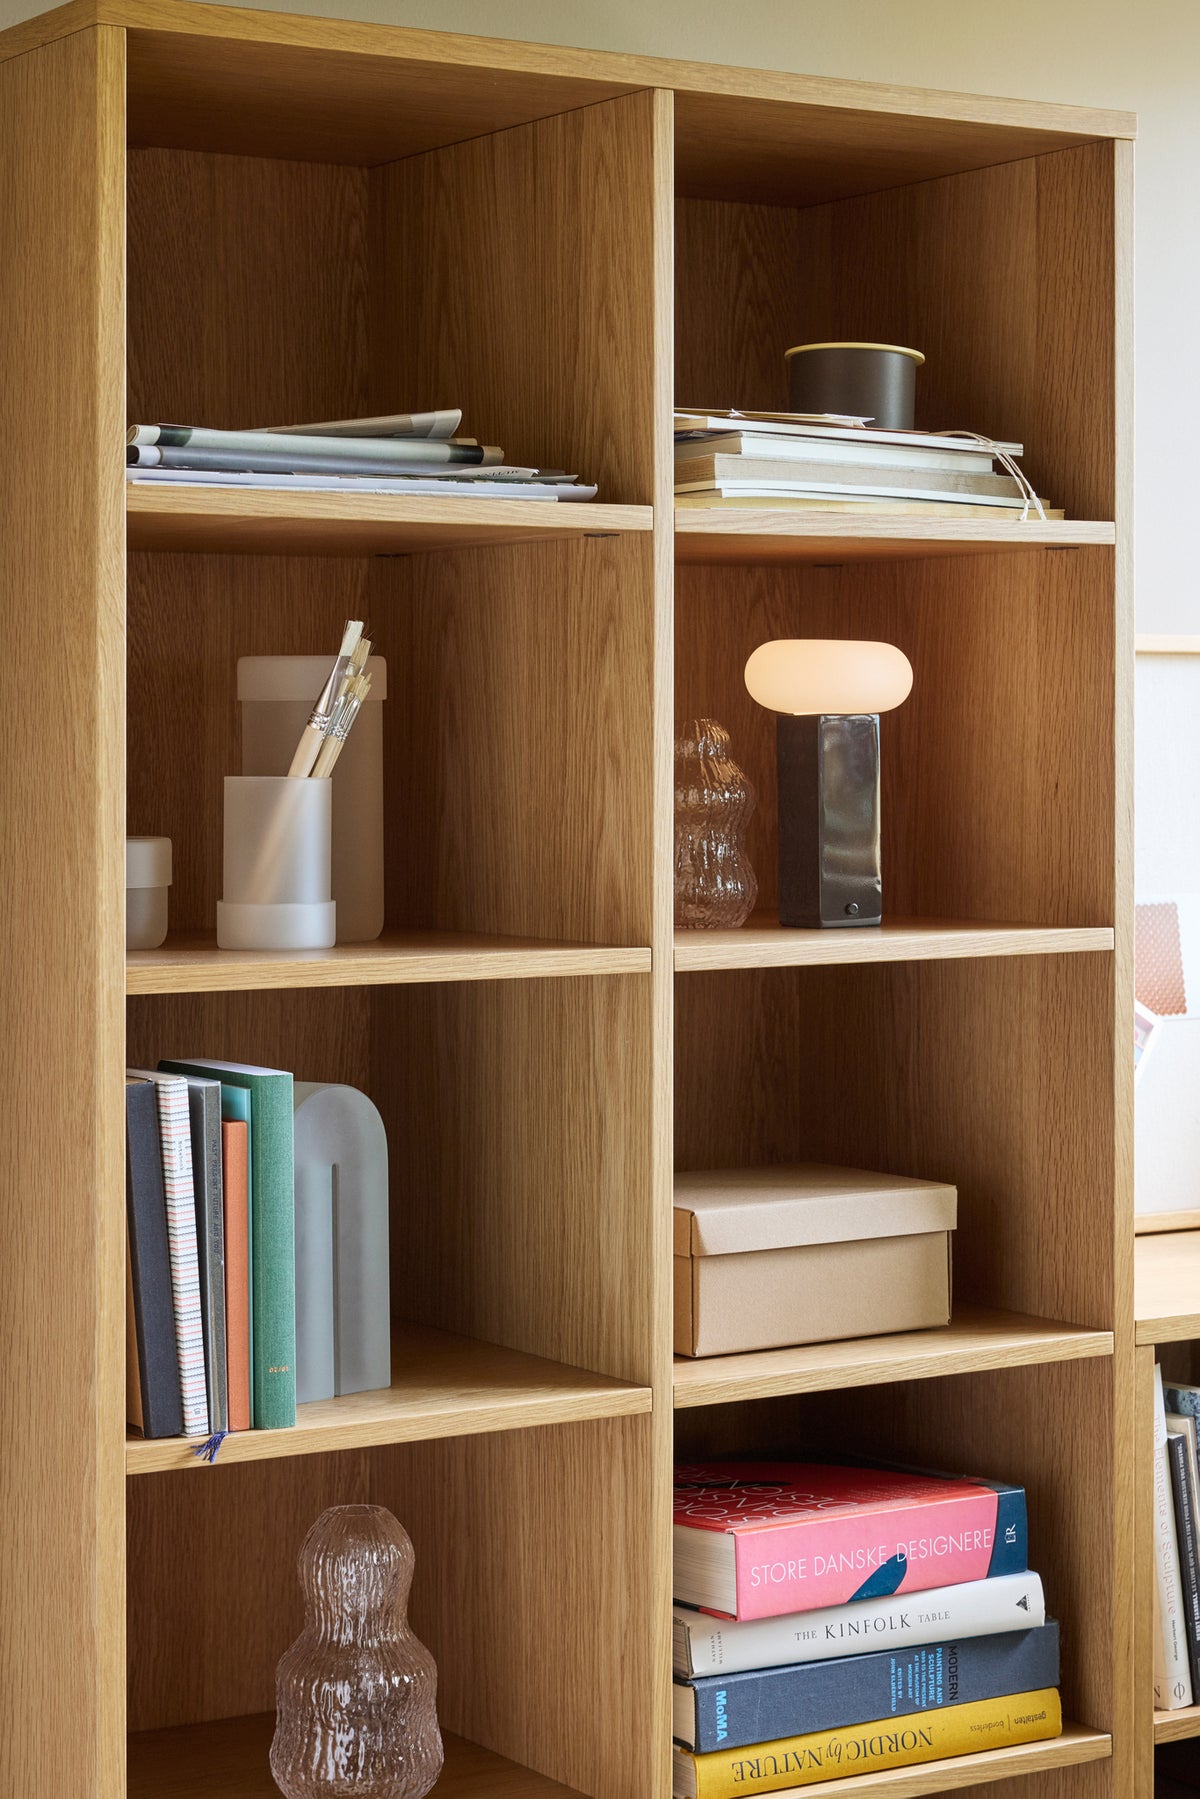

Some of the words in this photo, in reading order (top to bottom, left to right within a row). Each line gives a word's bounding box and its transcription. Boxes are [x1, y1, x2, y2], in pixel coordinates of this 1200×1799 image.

[751, 1558, 806, 1586] STORE
[814, 1546, 887, 1576] DANSKE
[896, 1528, 992, 1562] DESIGNERE
[1162, 1541, 1176, 1616] Sculpture
[795, 1630, 818, 1641] THE
[824, 1614, 911, 1640] KINFOLK
[918, 1610, 950, 1623] TABLE
[948, 1645, 958, 1701] MODERN
[716, 1690, 728, 1742] MoMA
[970, 1720, 1004, 1732] borderless
[1014, 1710, 1046, 1724] gestalten
[826, 1737, 842, 1763] by
[846, 1727, 934, 1760] NORDIC
[731, 1746, 822, 1782] NATURE
